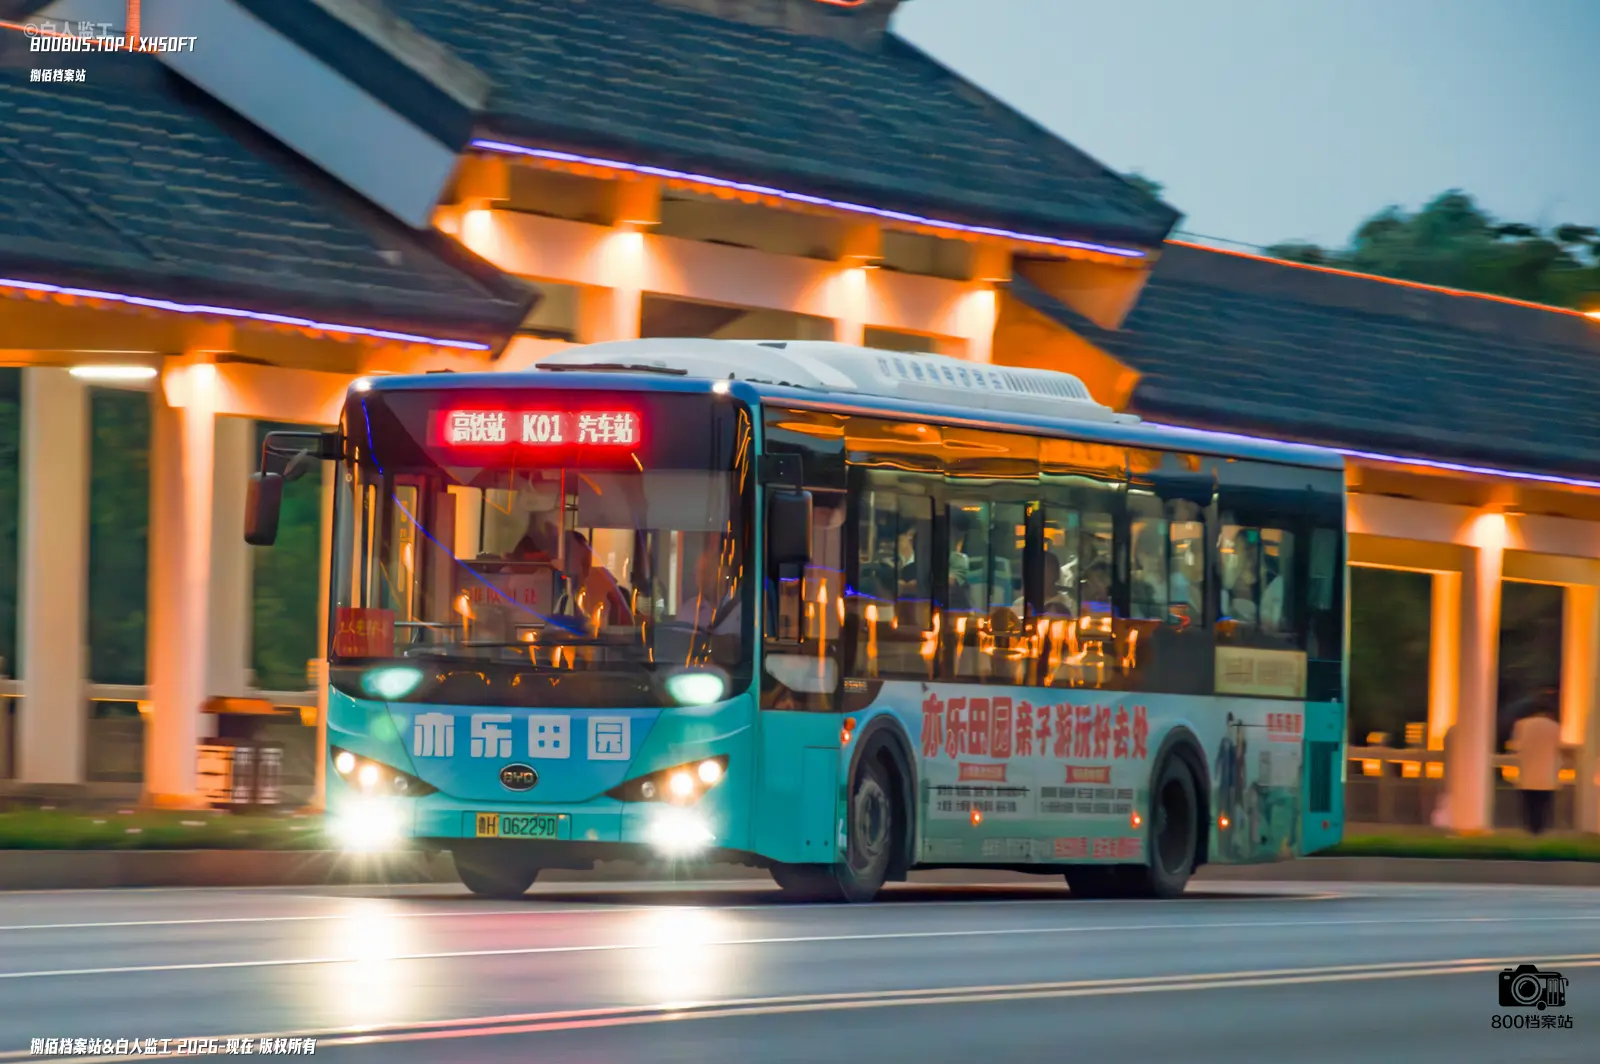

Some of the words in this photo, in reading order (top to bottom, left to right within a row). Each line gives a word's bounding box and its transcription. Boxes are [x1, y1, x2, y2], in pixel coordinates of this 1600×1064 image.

[452, 413, 506, 442] 高铁站
[522, 414, 562, 442] K01
[578, 414, 633, 443] 汽车站
[414, 712, 631, 761] 亦乐田园
